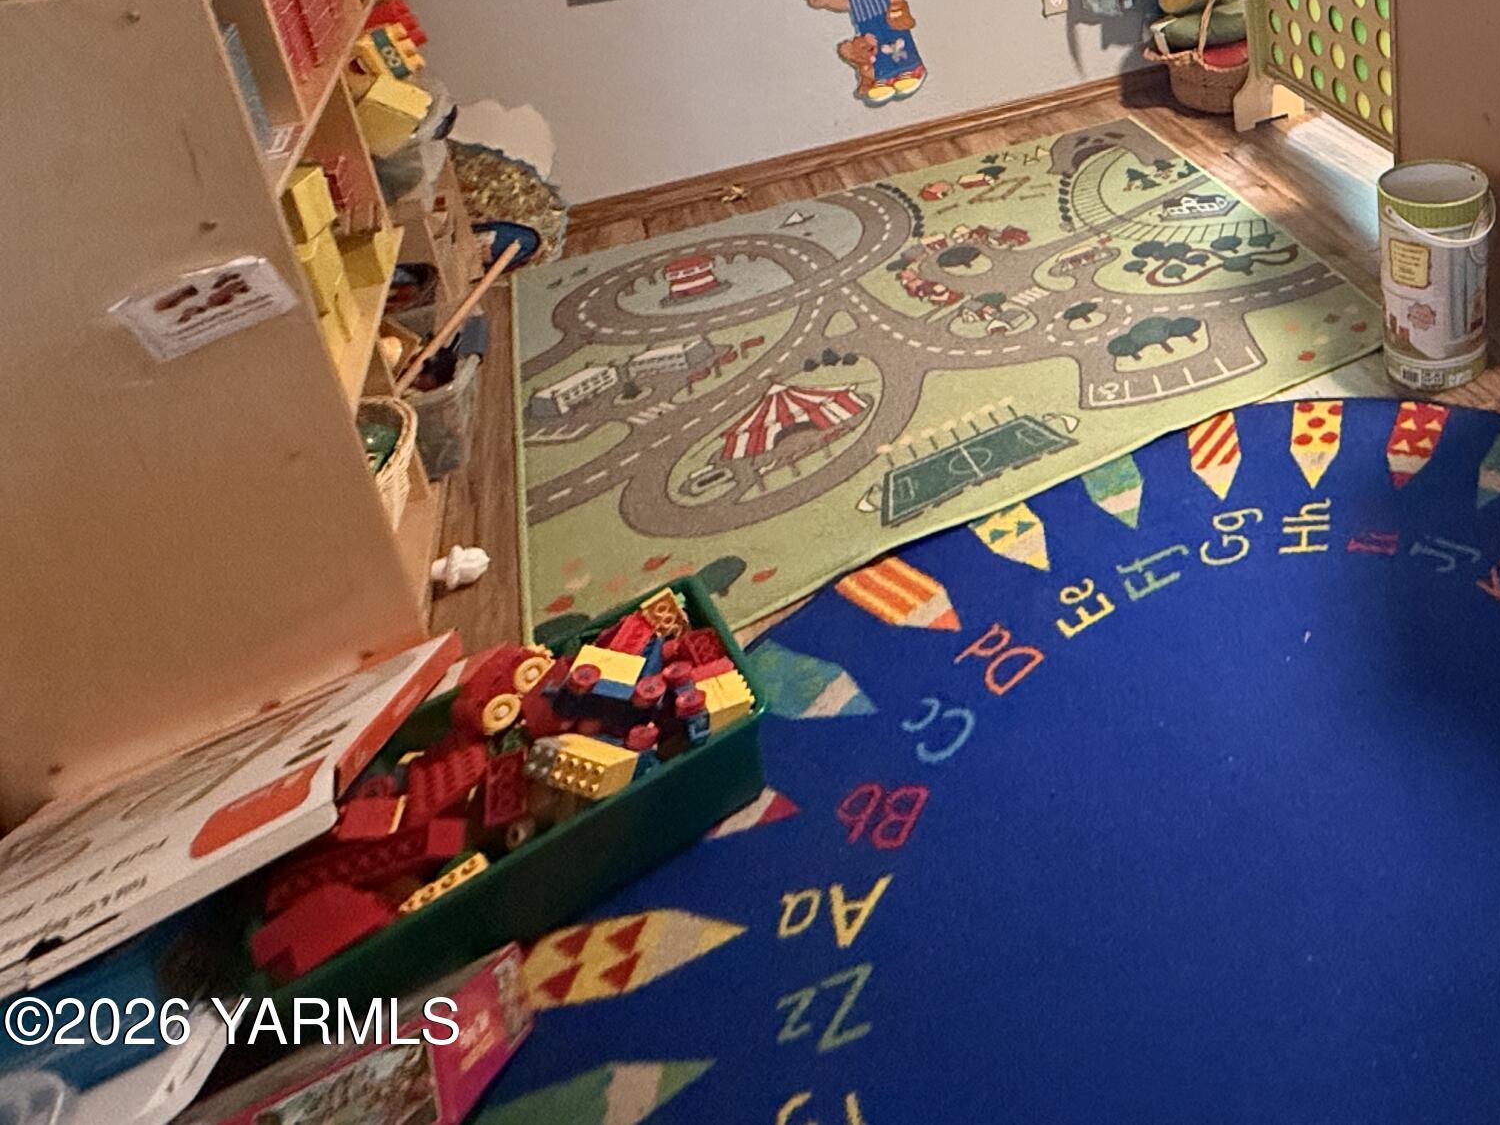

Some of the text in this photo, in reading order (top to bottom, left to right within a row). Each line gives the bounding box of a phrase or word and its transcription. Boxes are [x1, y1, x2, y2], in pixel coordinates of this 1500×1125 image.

[1199, 507, 1263, 566] Gg
[1278, 498, 1331, 554] Hh
[1116, 543, 1190, 601] Ff
[1055, 577, 1116, 639] Ee
[953, 622, 1045, 696] Dd
[901, 697, 976, 764] Cc
[836, 782, 931, 851] Bb
[776, 874, 894, 948] Aa
[775, 963, 874, 1053] Zz
